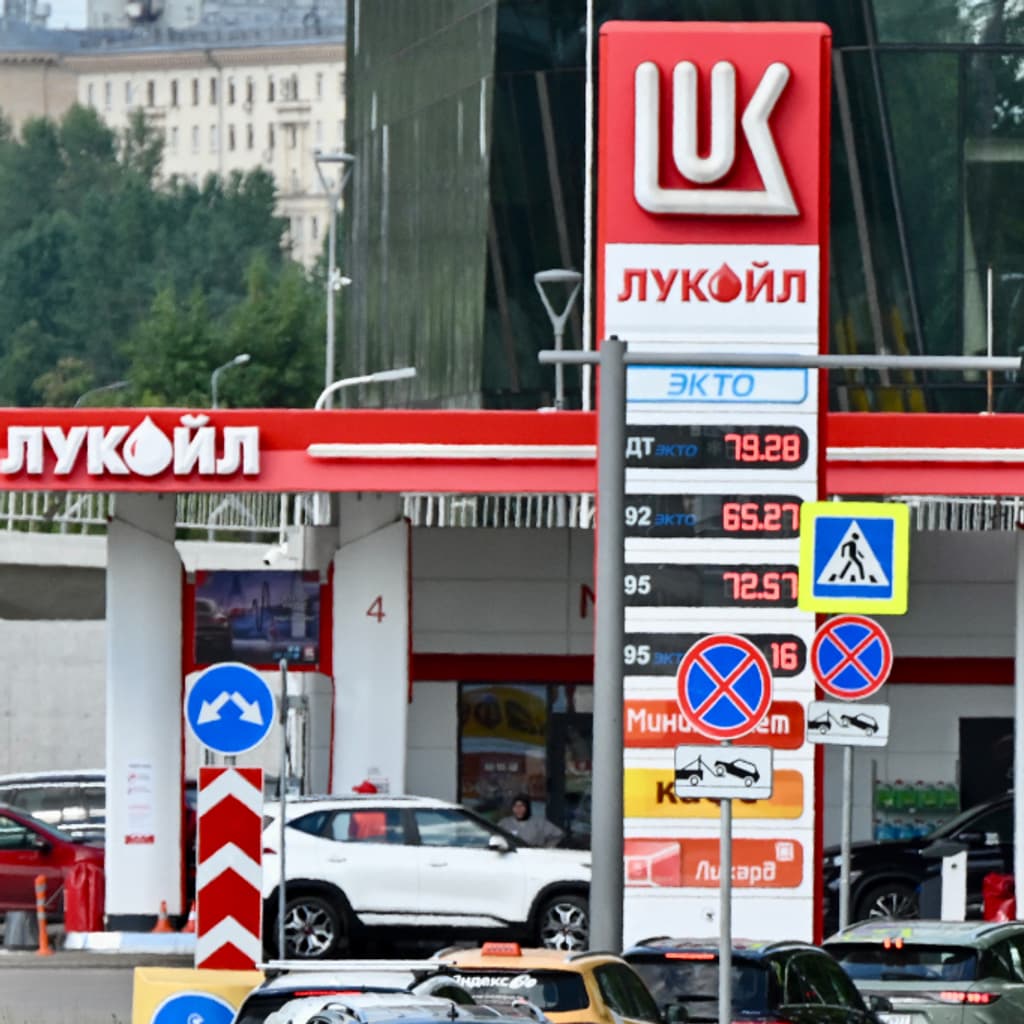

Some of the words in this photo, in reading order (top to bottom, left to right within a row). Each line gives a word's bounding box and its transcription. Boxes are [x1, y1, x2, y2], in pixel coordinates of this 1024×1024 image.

[617, 260, 807, 304] ЛУКОЙЛ
[667, 372, 755, 397] ЭКТО
[0, 414, 260, 476] ЛУКОЙЛ
[625, 436, 655, 459] ДТ
[655, 444, 699, 457] ЭКТО
[724, 433, 801, 463] 79.28
[625, 506, 652, 526] 92
[655, 513, 697, 526] ЭКТО
[722, 502, 799, 532] 65.27
[624, 574, 651, 595] 95
[723, 571, 798, 600] 72.57
[366, 595, 386, 623] 4
[624, 645, 650, 665] 95
[654, 652, 684, 665] ЭКТ
[627, 708, 790, 735] Миниет
